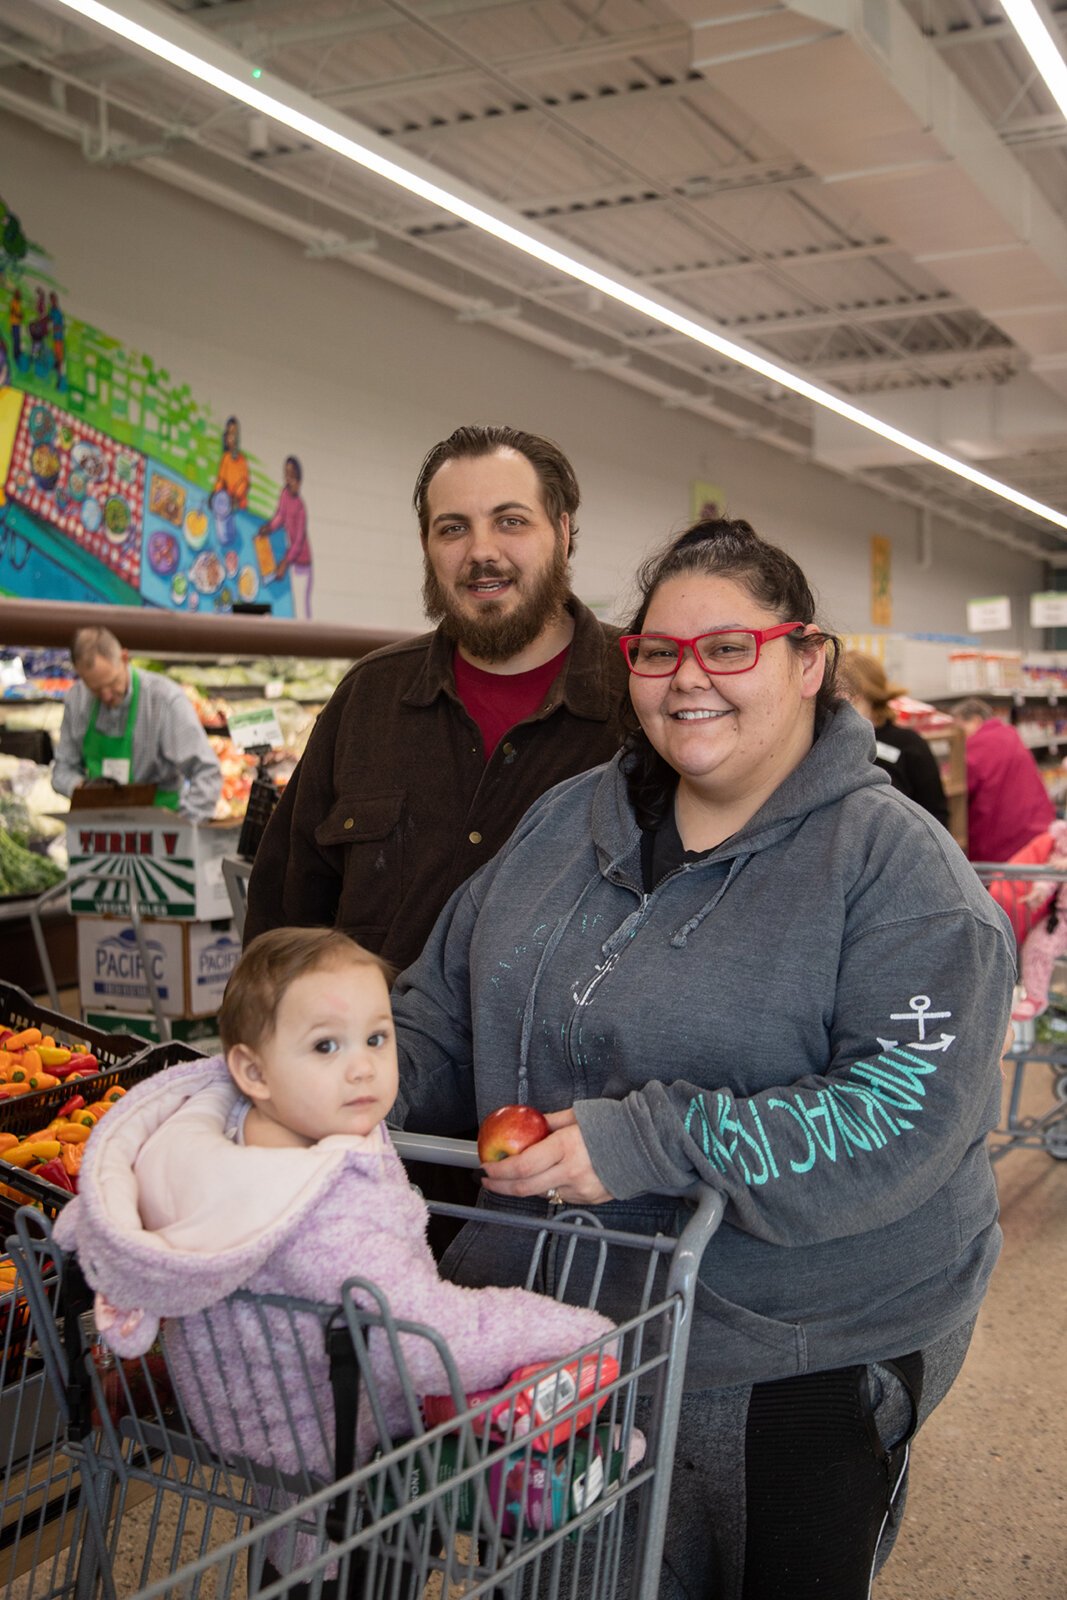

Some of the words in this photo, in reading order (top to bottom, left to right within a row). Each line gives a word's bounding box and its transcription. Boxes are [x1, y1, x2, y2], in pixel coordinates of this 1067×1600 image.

[80, 832, 153, 855] THREE
[163, 833, 178, 855] V
[95, 902, 168, 915] VEGETBLES
[96, 950, 164, 979] PACIFC
